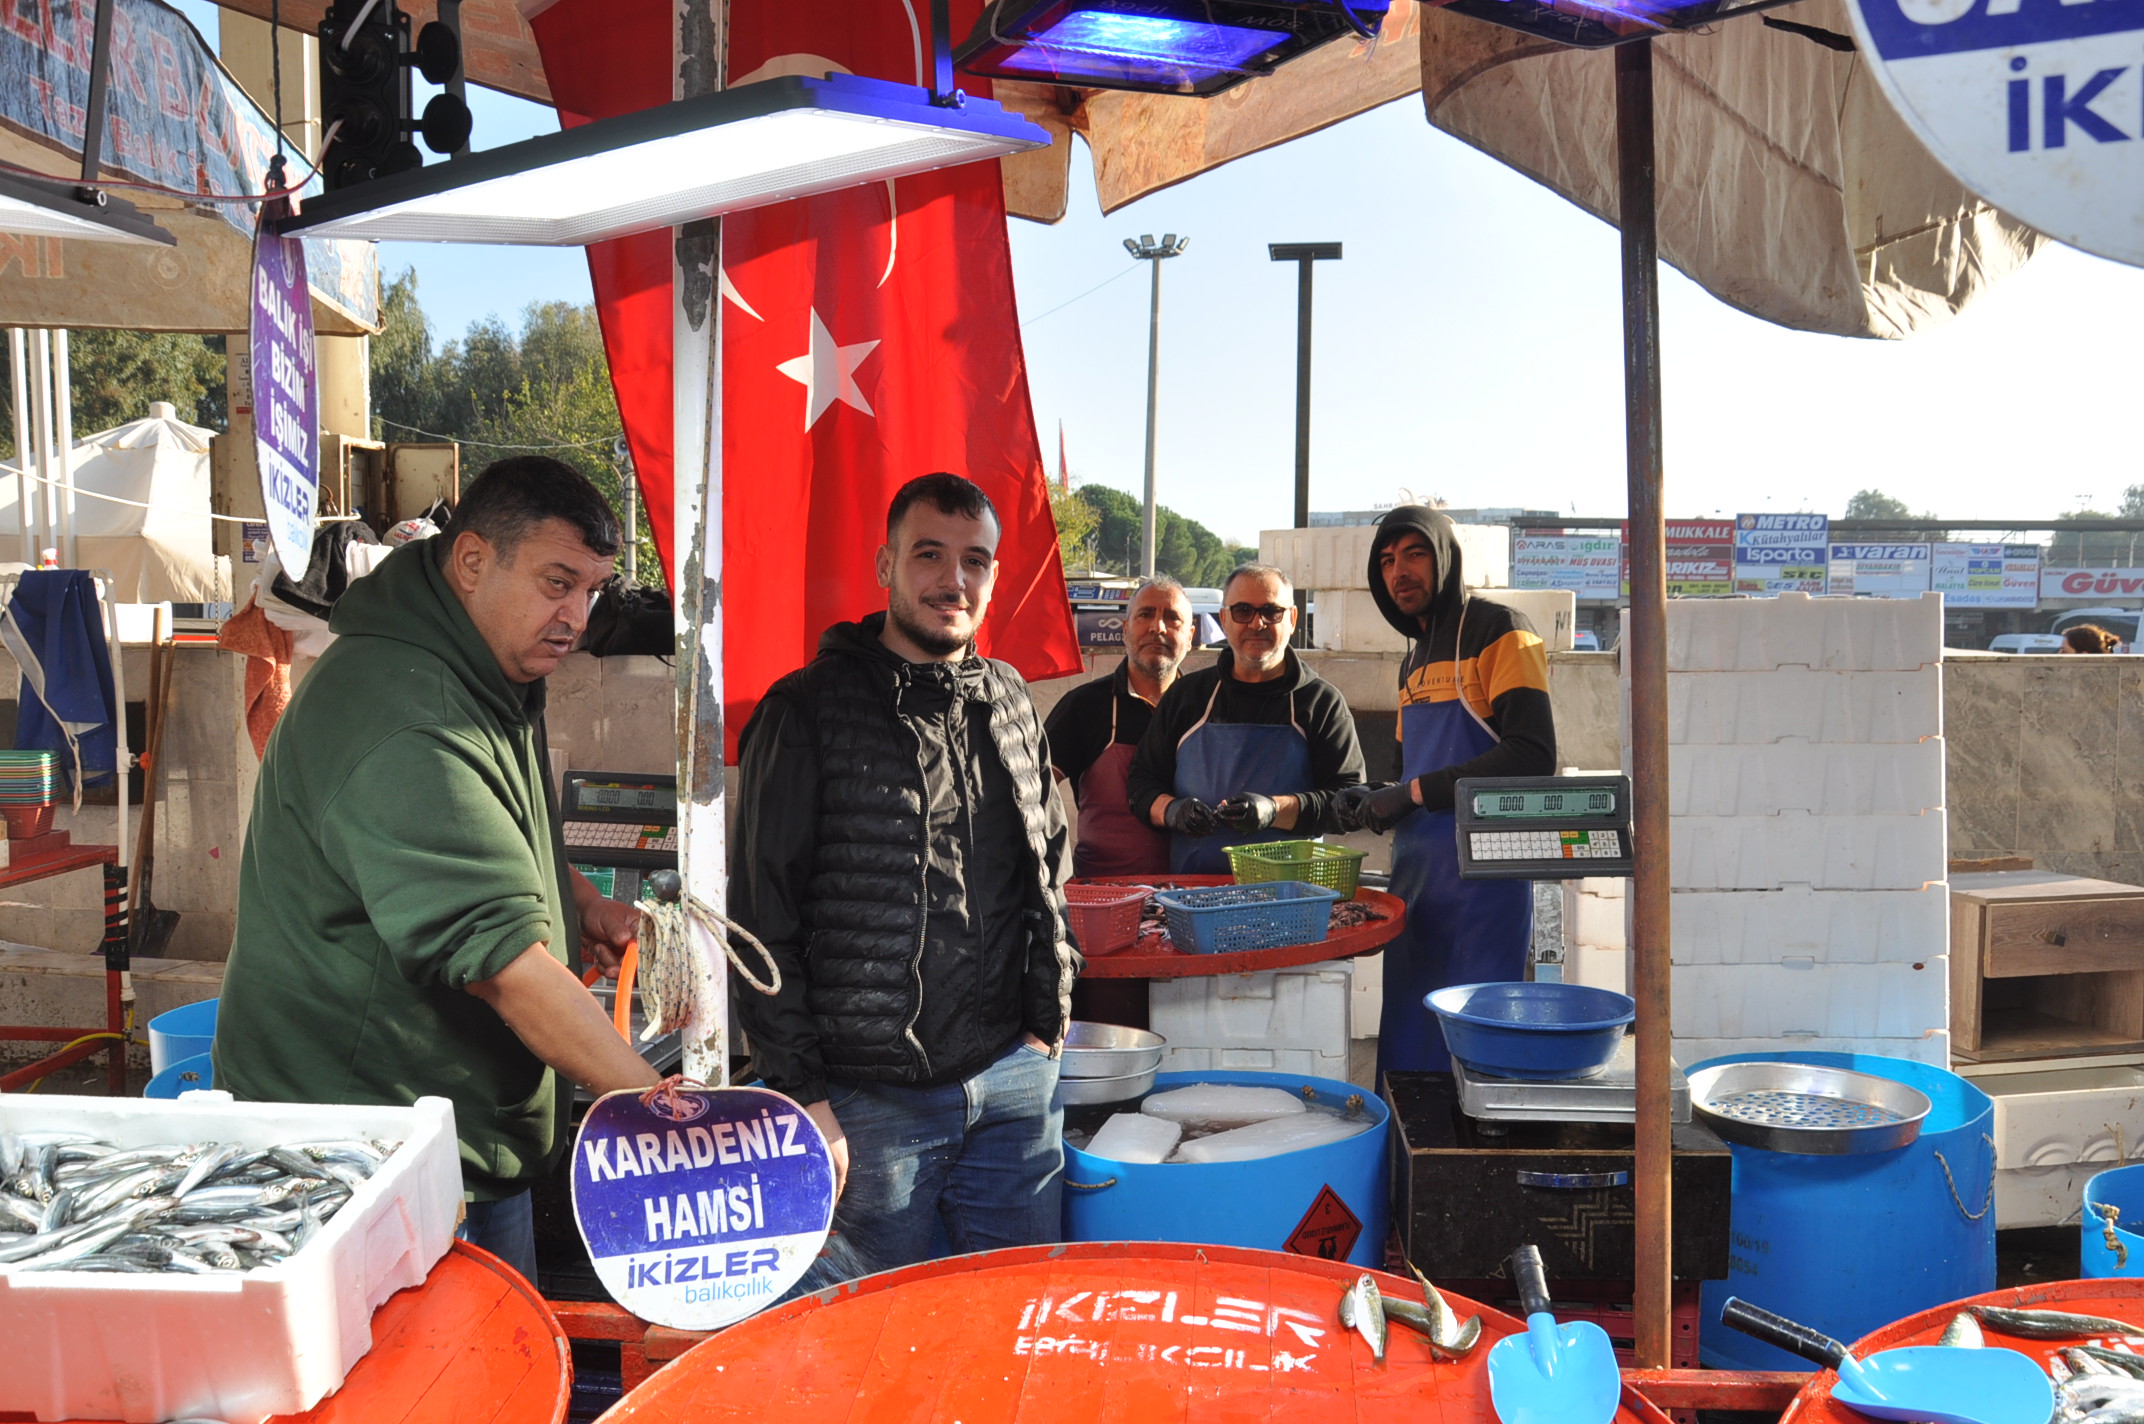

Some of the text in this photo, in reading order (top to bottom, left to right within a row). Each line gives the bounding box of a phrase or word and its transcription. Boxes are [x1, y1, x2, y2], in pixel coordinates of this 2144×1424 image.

[2008, 56, 2144, 153] İK
[259, 263, 313, 374] BALIK İŞİ
[272, 339, 306, 413] BİZİM
[270, 387, 309, 468] İŞİMİZ
[269, 451, 310, 526] İKİZLER
[1665, 526, 1730, 538] MUKKALE
[1757, 515, 1824, 530] METRO
[1527, 541, 1565, 550] ARAS
[1746, 547, 1815, 563] Isparta
[1854, 546, 1926, 559] varan
[1665, 561, 1717, 575] ARIKIZ
[1090, 632, 1123, 642] PELAG
[583, 1108, 807, 1183] KARADENİZ
[643, 1173, 765, 1243] HAMSİ
[627, 1248, 781, 1290] İKİZLER
[685, 1276, 774, 1304] balıkçılık
